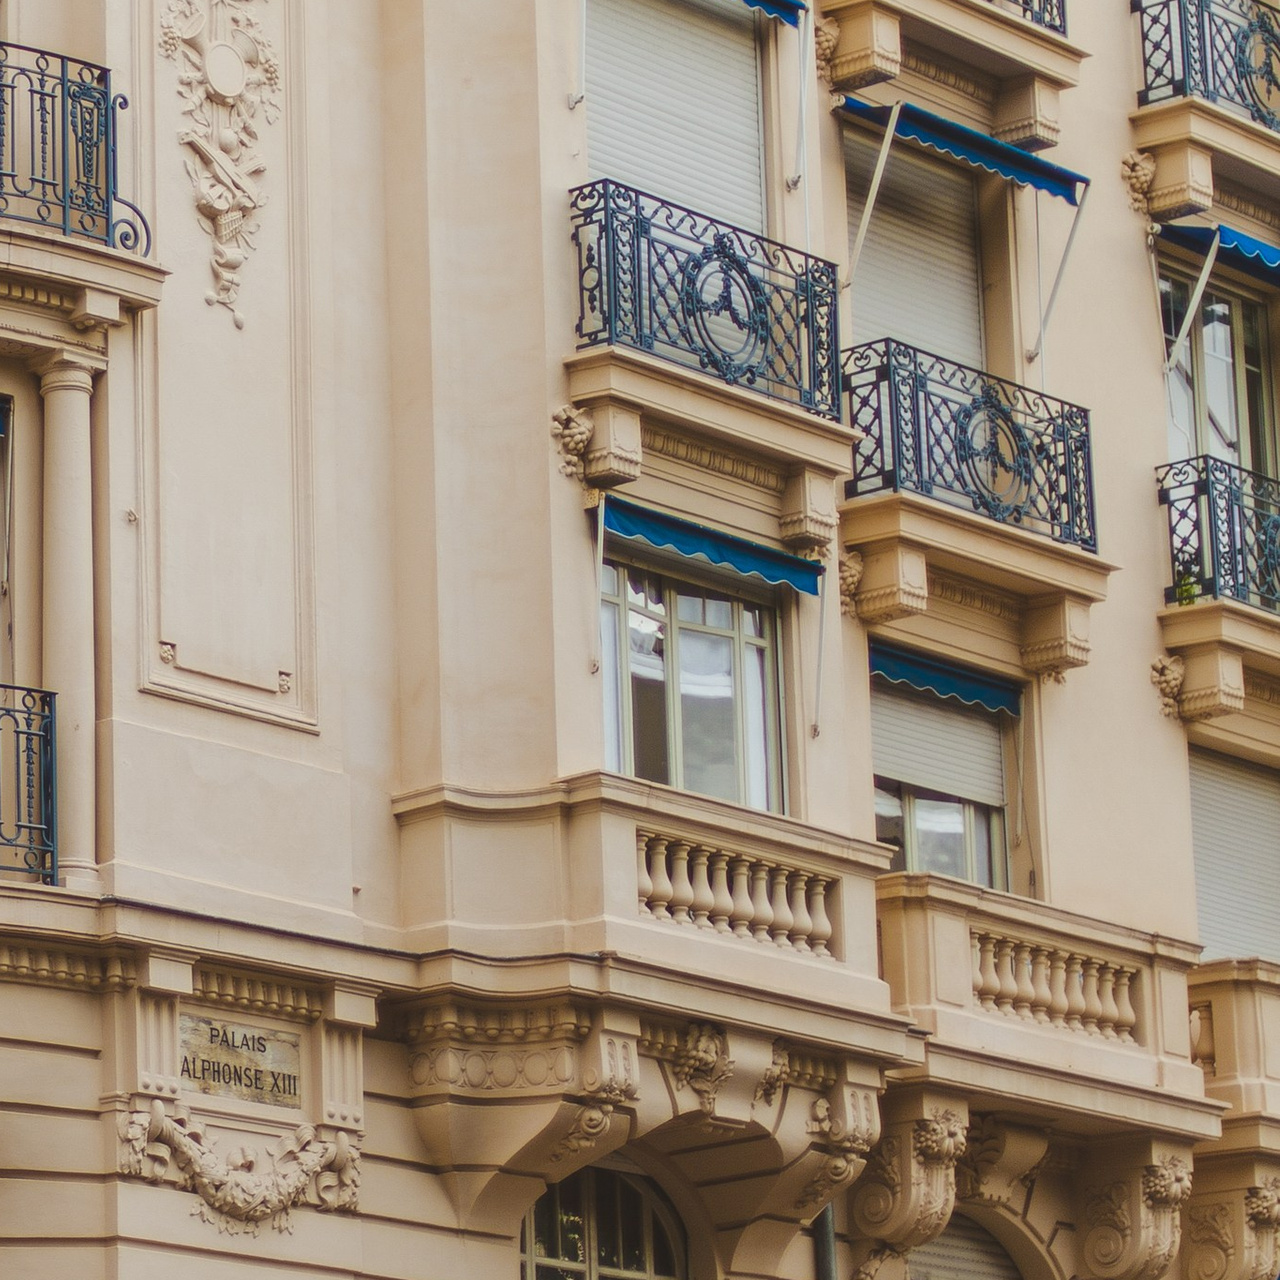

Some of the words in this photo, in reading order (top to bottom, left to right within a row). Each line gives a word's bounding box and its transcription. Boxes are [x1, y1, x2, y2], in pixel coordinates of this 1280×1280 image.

[210, 1027, 267, 1053] PALAIS
[180, 1055, 264, 1090] ALPHONSE
[270, 1072, 297, 1096] XIII
